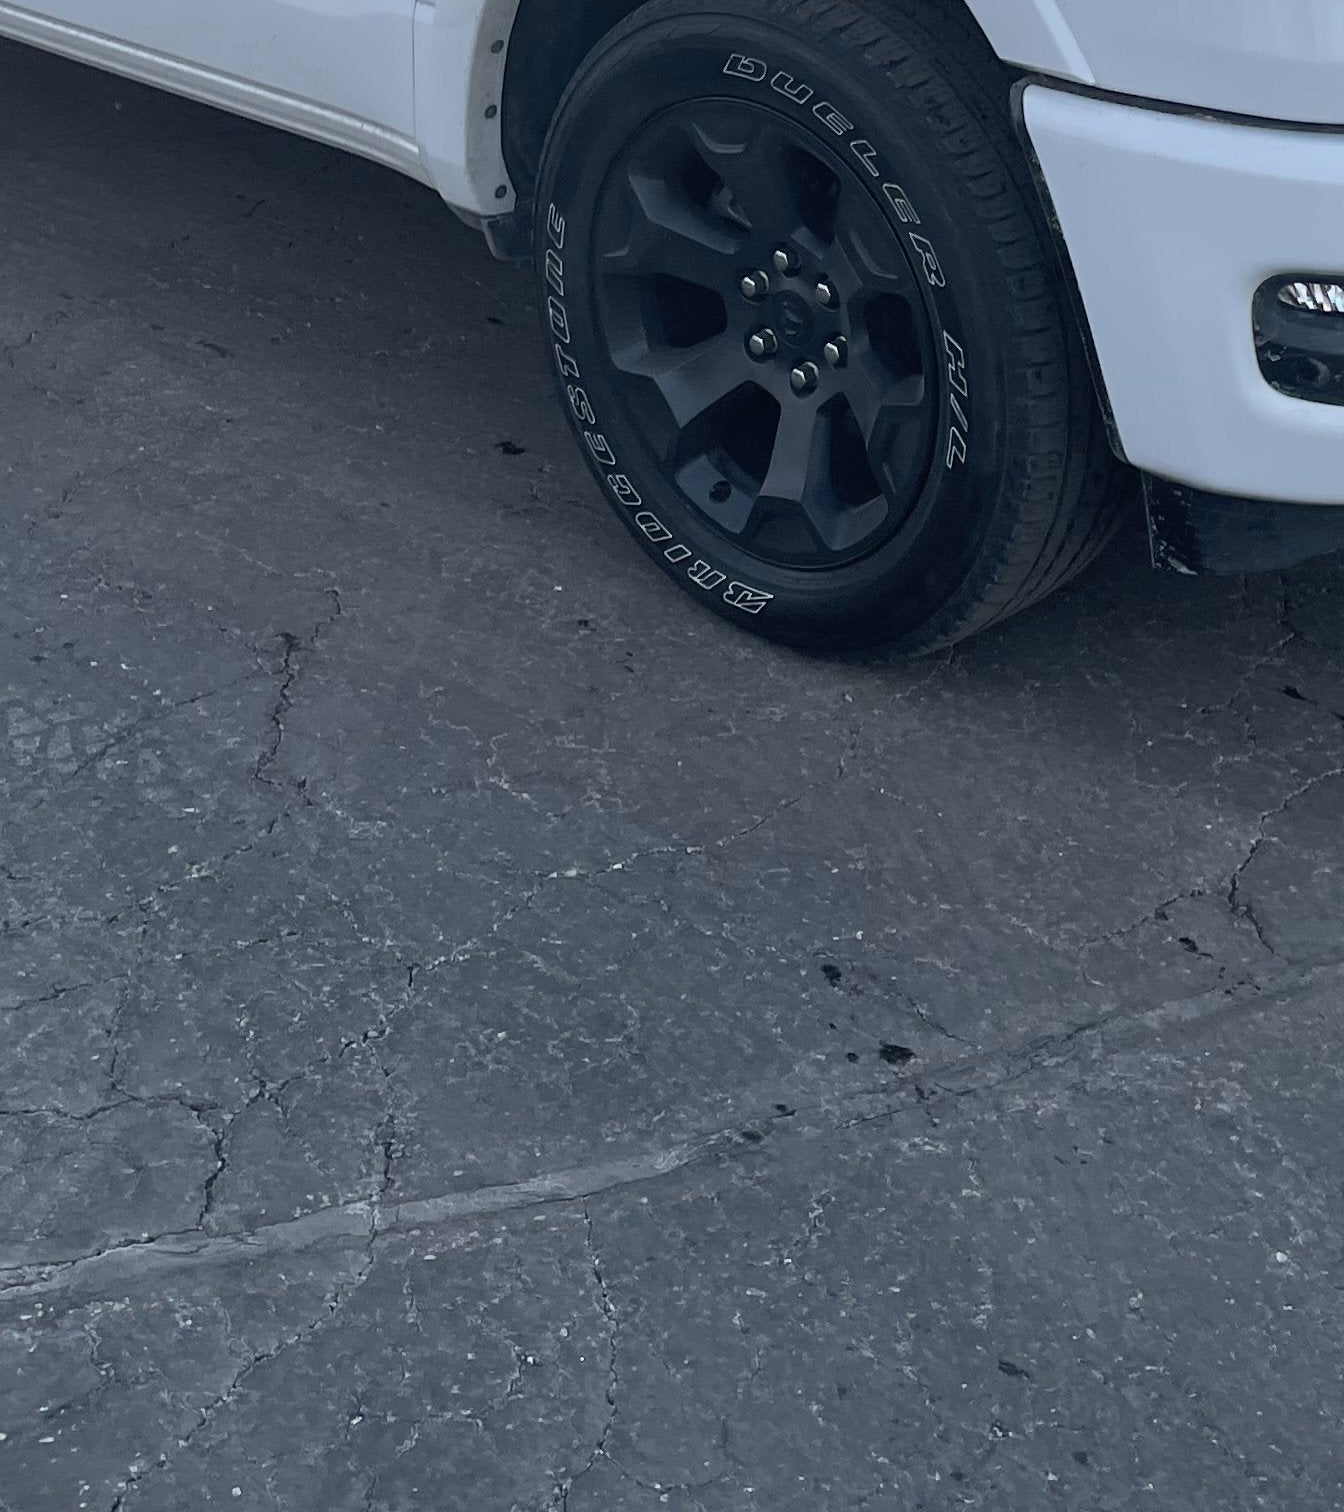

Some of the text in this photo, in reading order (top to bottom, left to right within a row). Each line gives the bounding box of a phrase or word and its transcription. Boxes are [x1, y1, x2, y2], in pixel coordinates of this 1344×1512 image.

[546, 201, 775, 615] BRIDGESTONE
[722, 52, 969, 470] DUELER H/L
